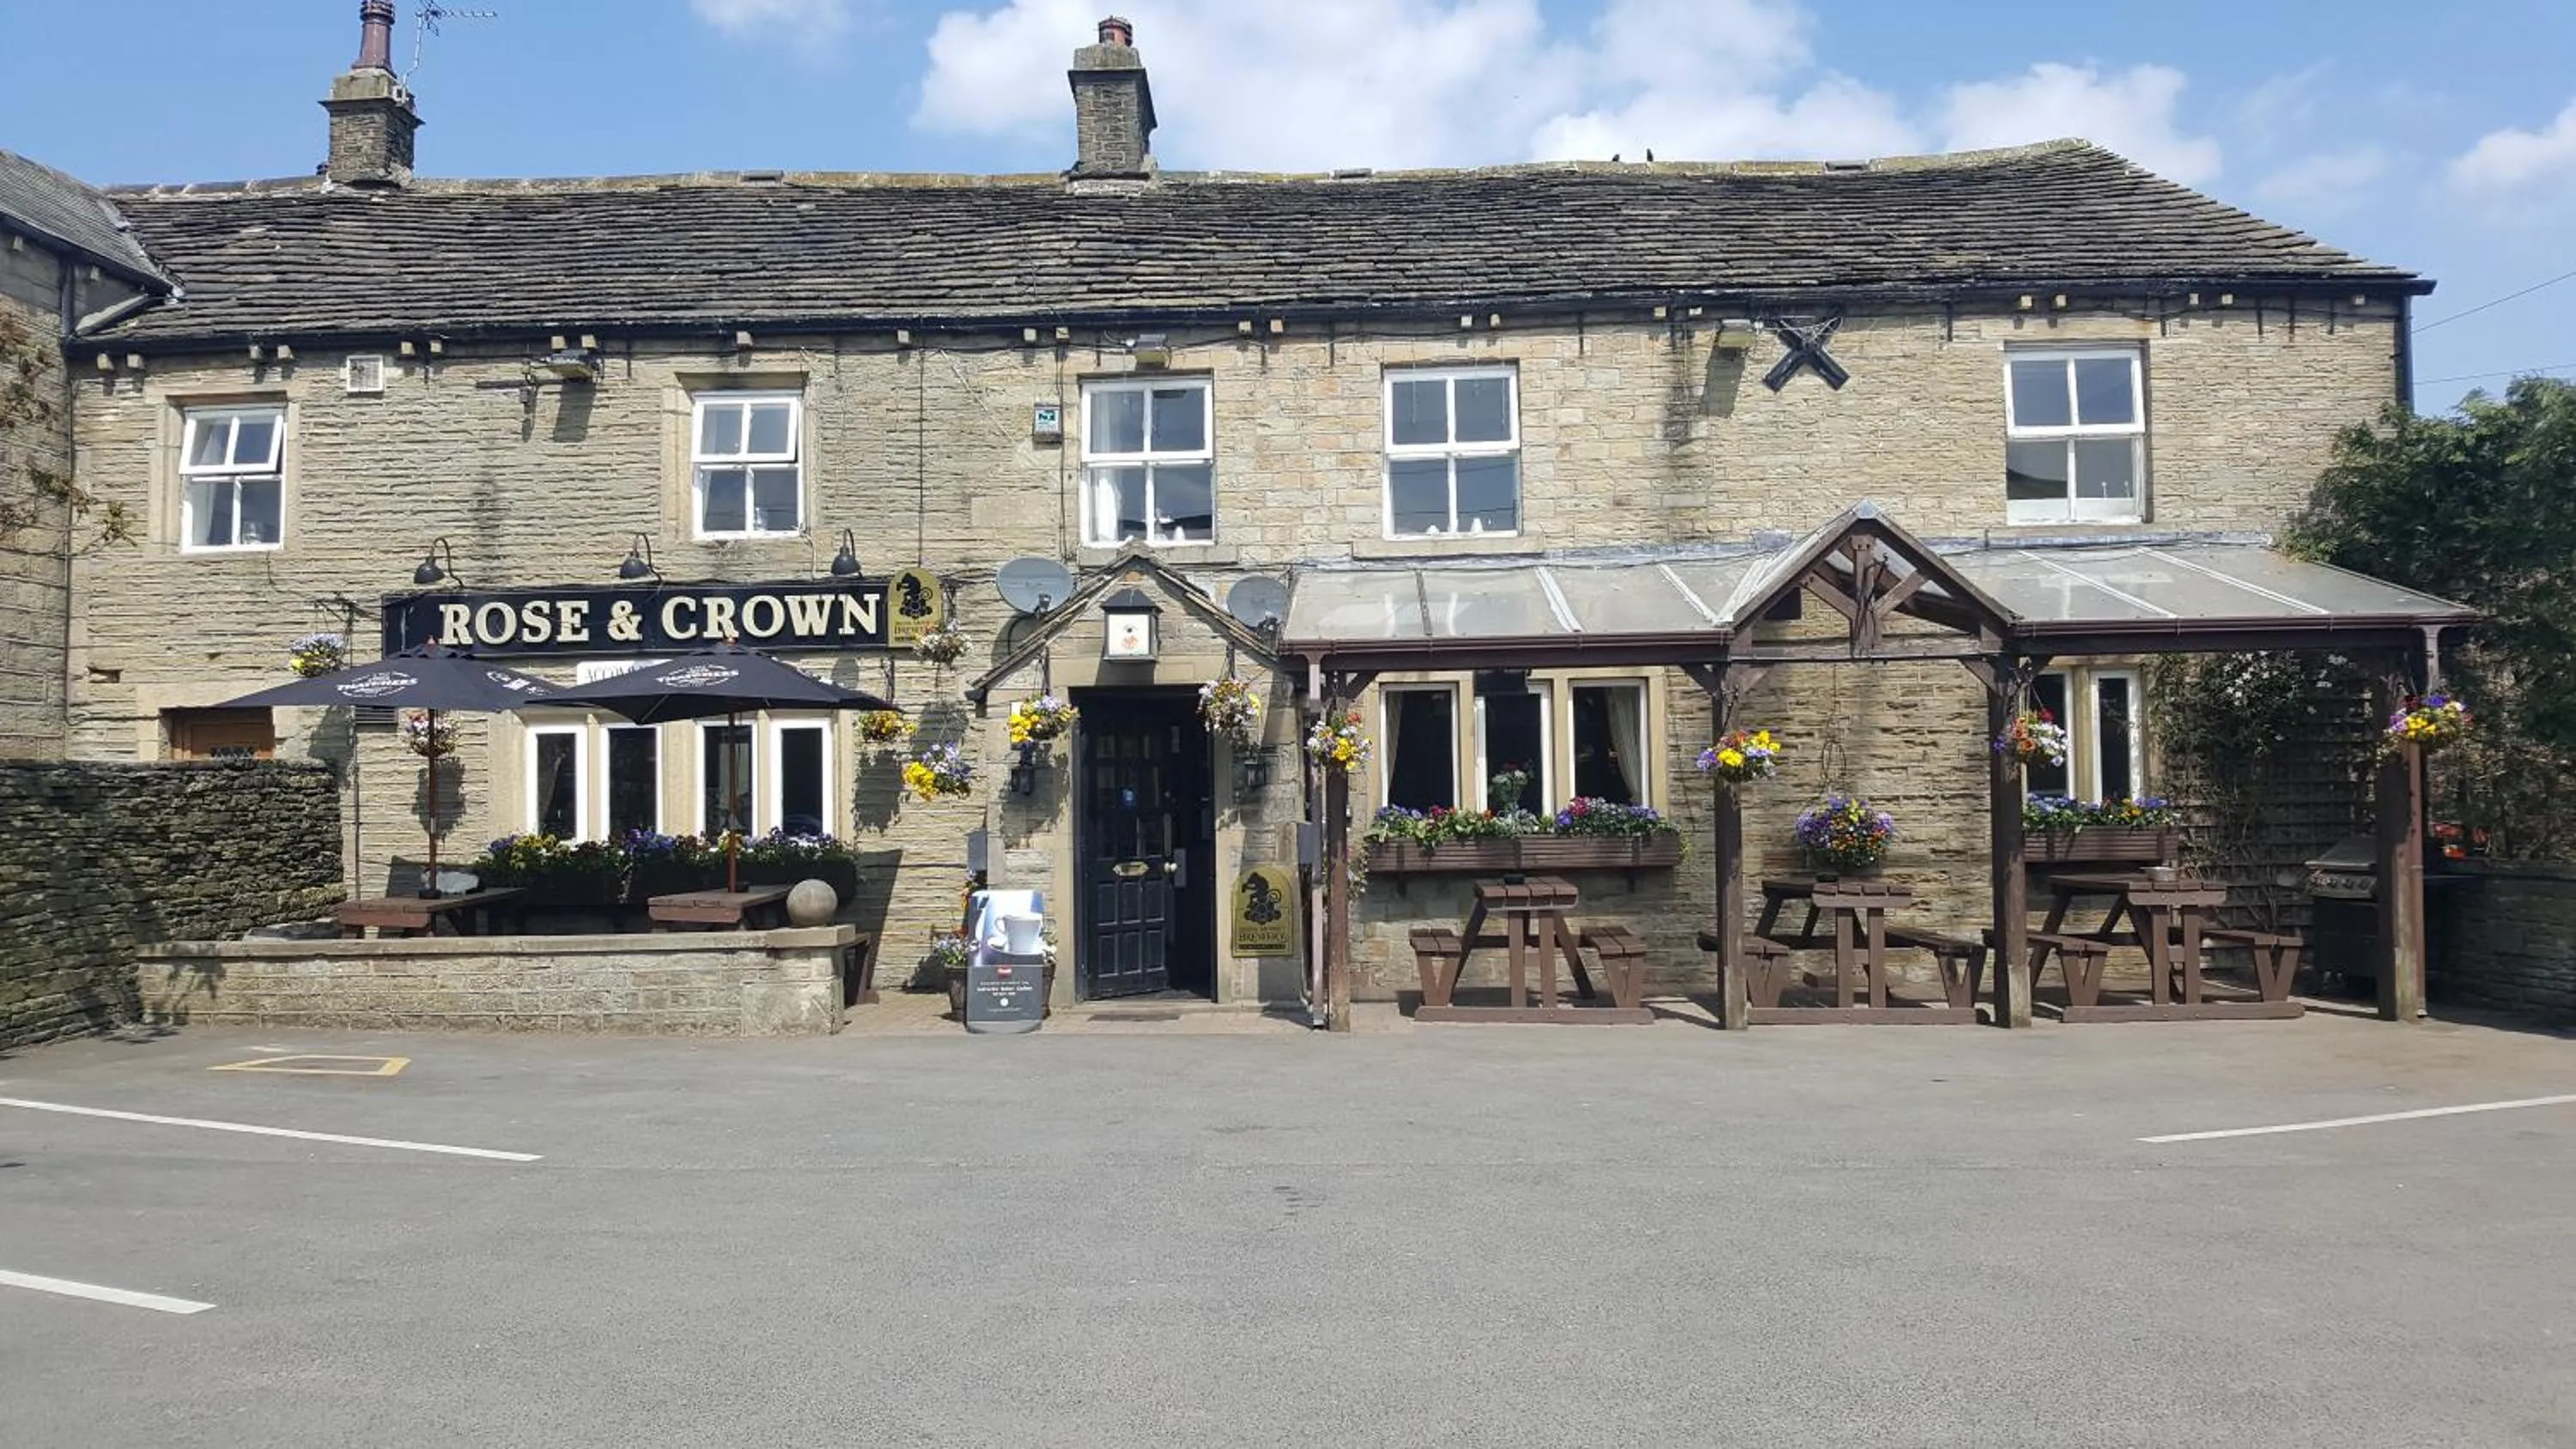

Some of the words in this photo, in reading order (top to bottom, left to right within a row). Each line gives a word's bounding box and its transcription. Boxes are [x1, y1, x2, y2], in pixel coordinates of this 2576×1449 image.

[439, 600, 590, 646] ROSE
[607, 600, 644, 641] &
[660, 593, 881, 642] CROWN
